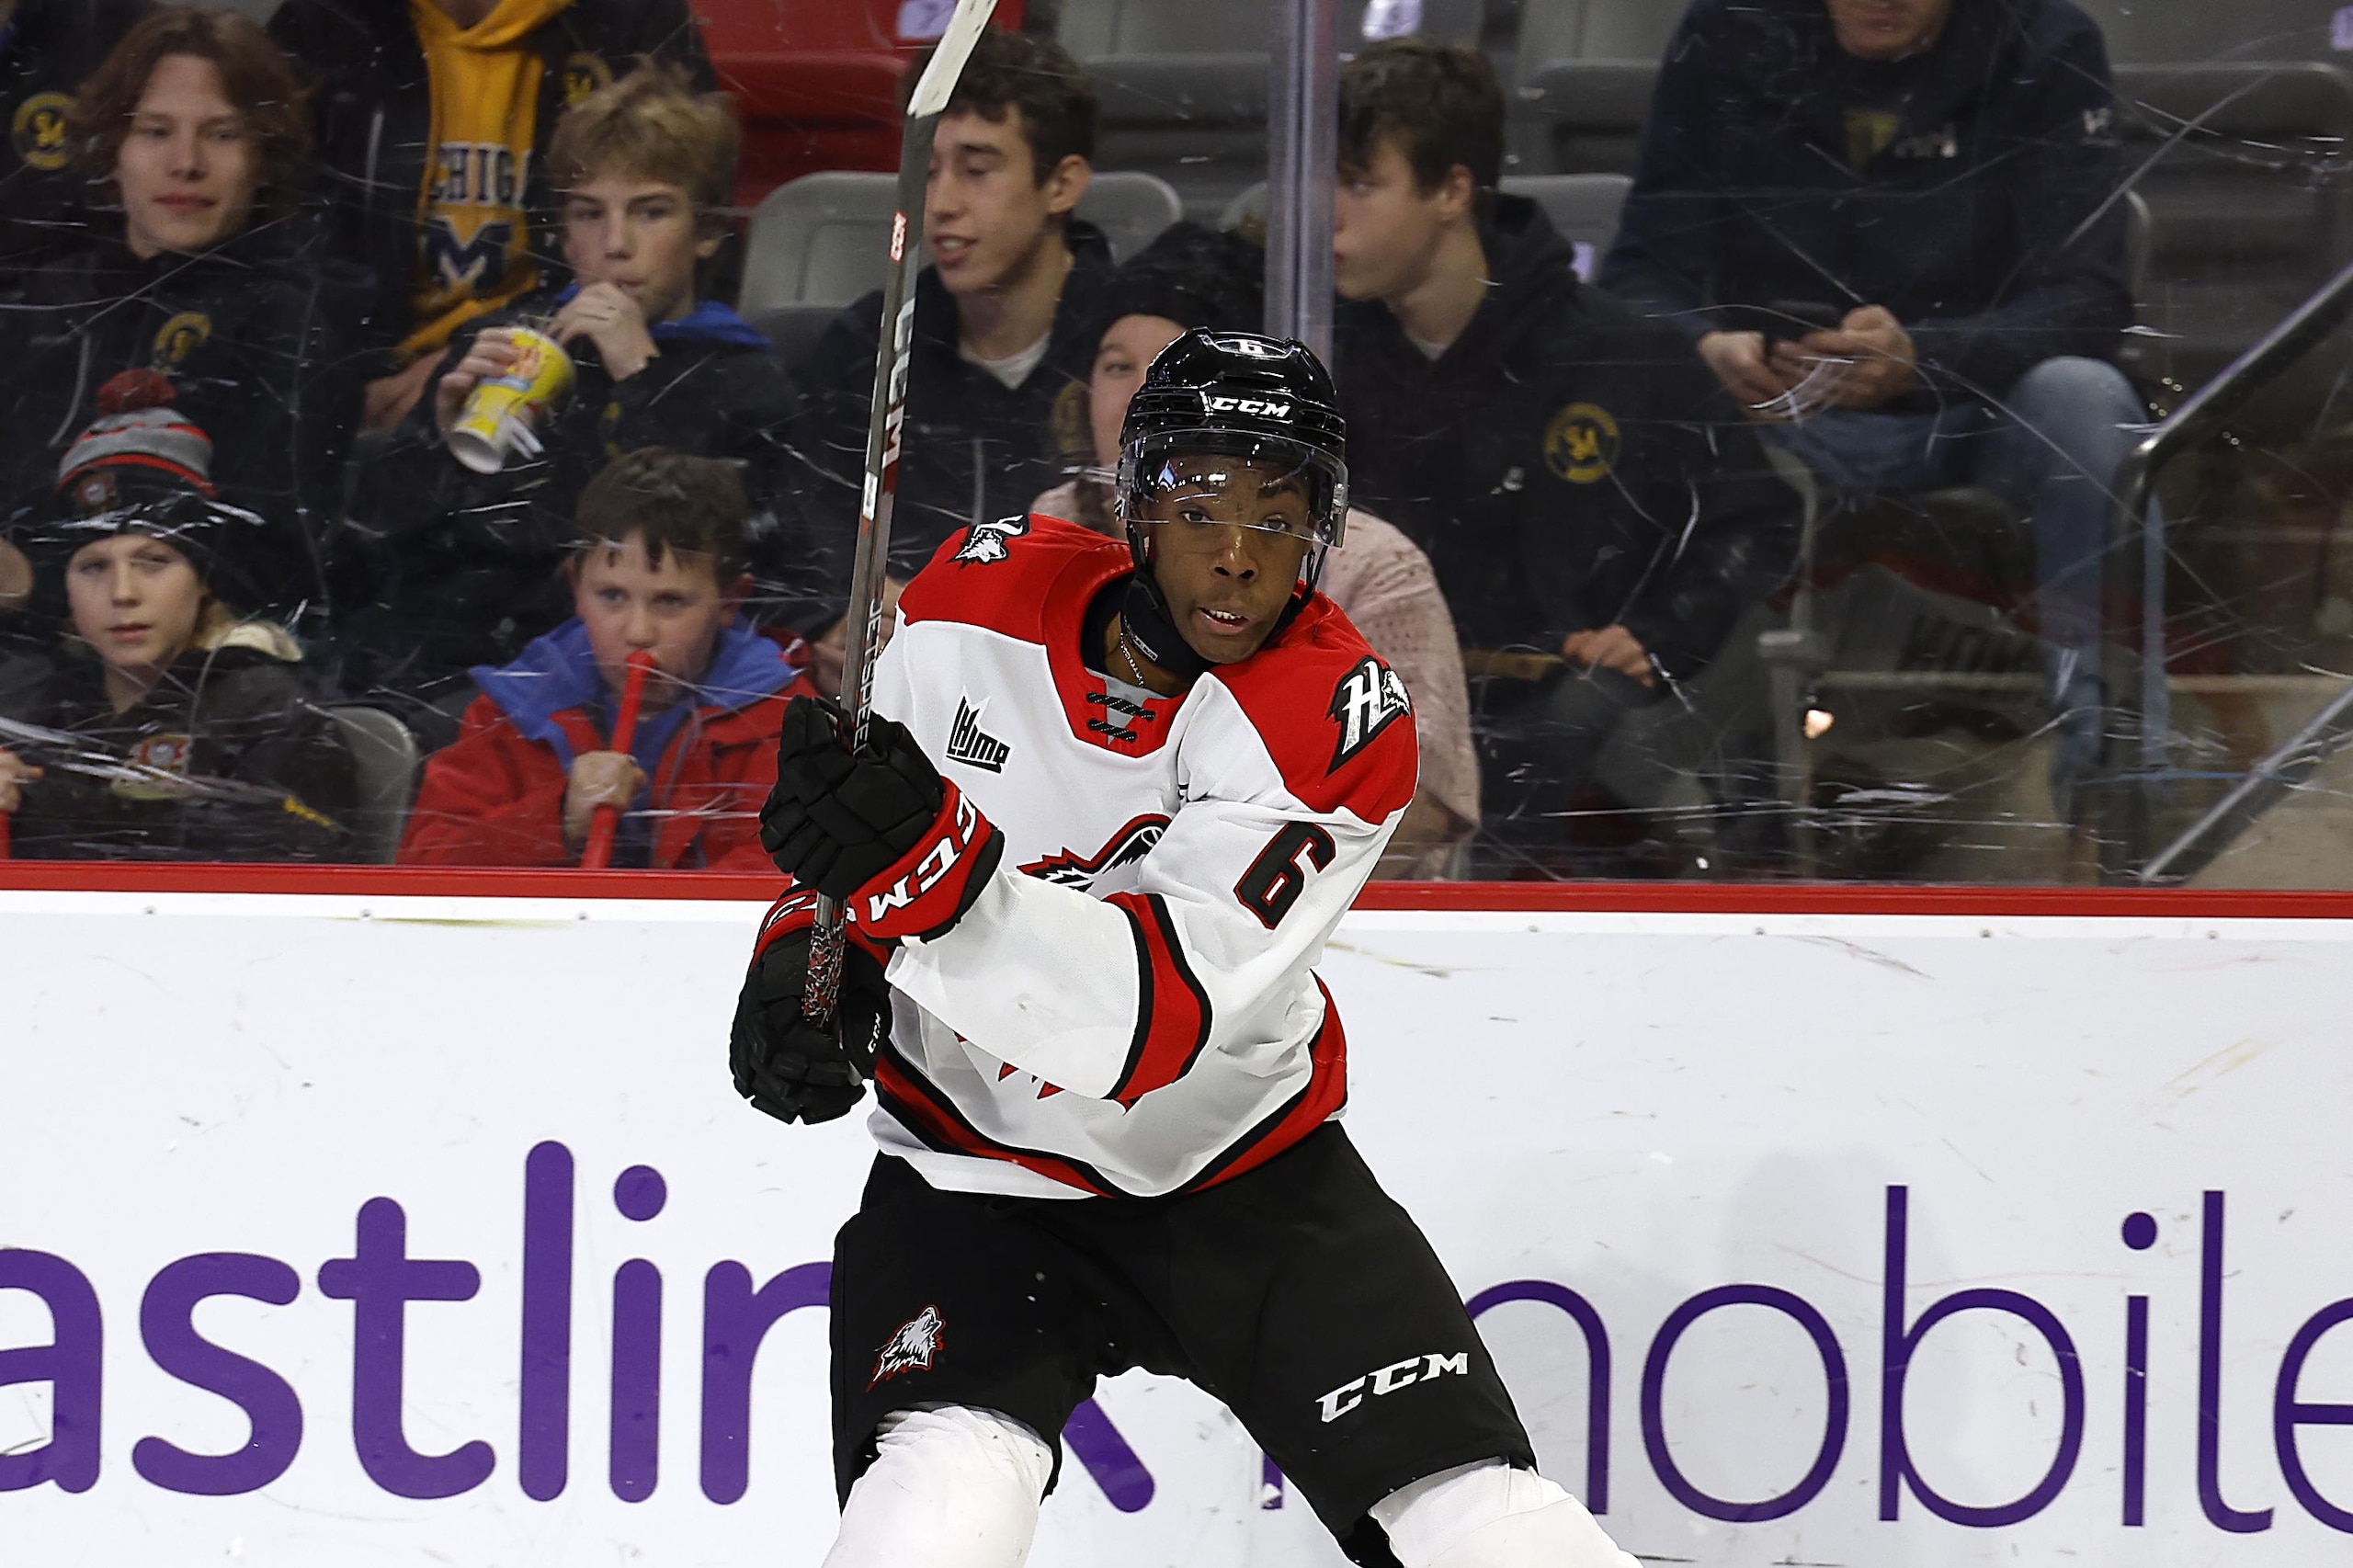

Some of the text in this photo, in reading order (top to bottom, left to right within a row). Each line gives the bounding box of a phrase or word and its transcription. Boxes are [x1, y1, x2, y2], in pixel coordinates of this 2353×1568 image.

[880, 296, 917, 471] CCM
[1211, 395, 1291, 418] CCM
[851, 597, 883, 757] JETSPEE
[868, 790, 976, 923] CCM
[1233, 820, 1337, 931] 6
[1314, 1351, 1469, 1424] CCM
